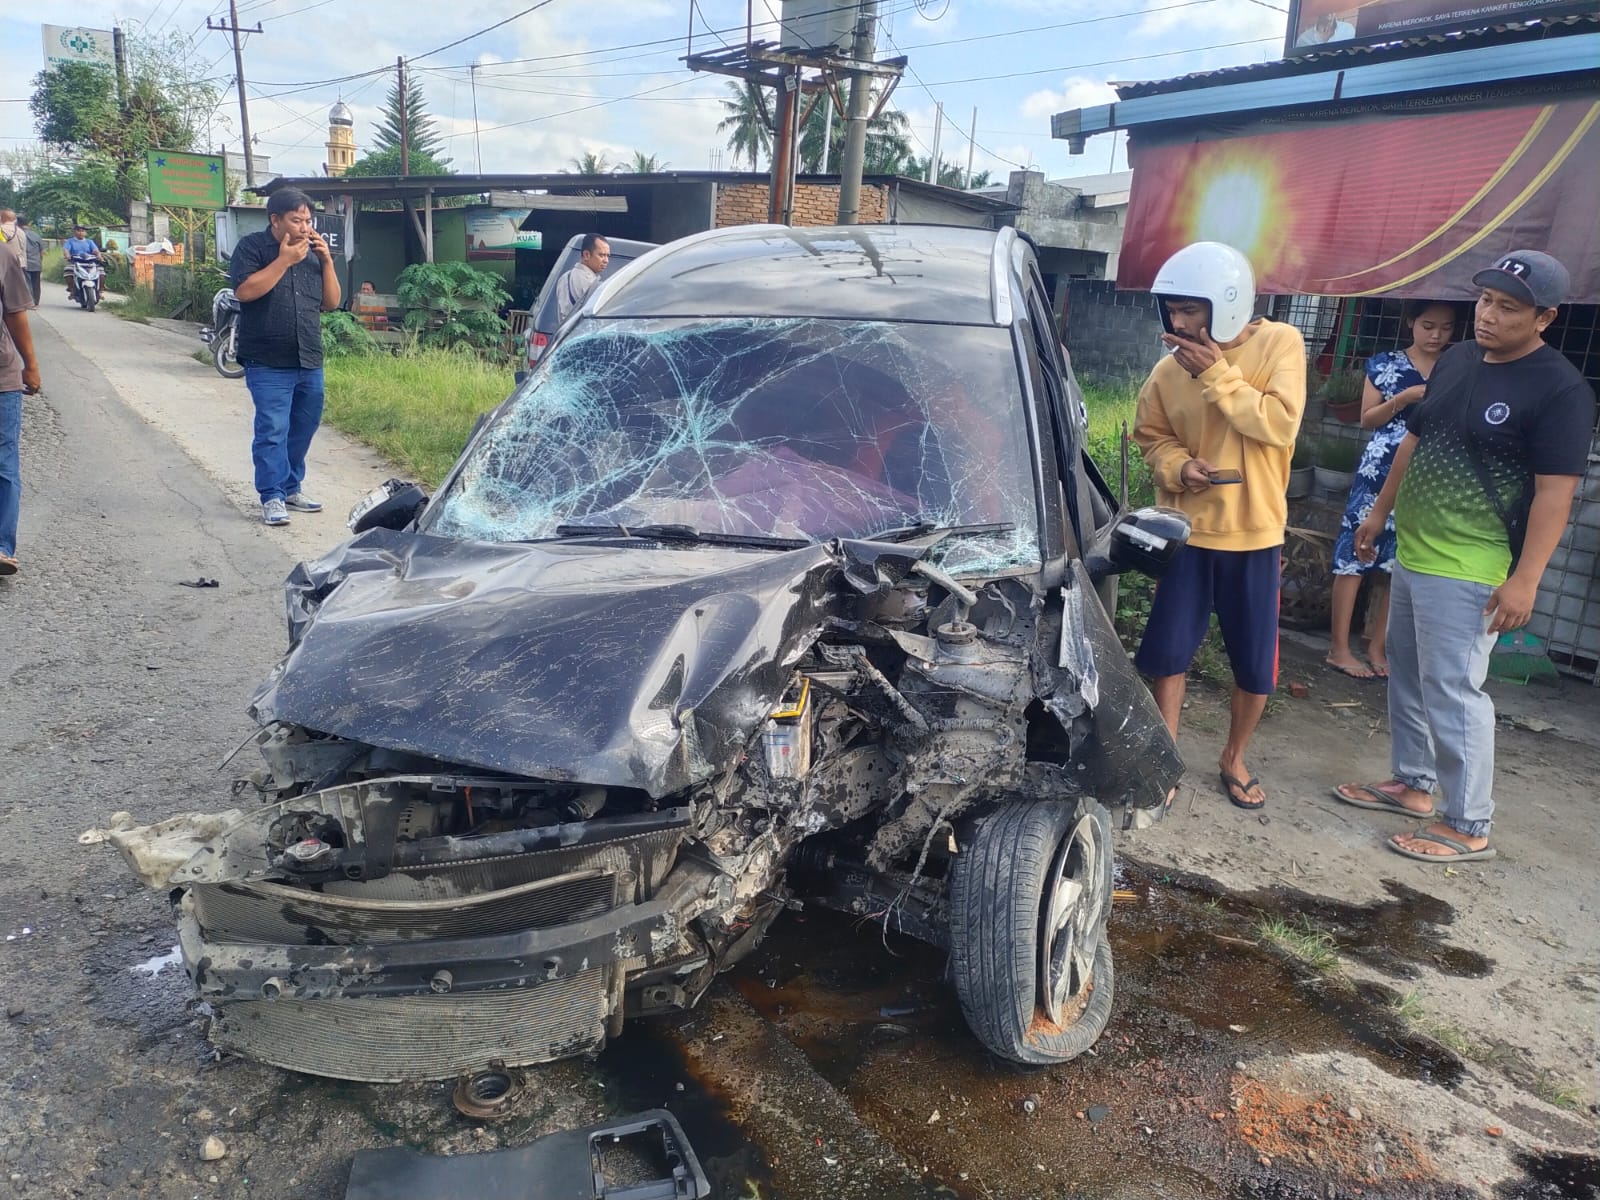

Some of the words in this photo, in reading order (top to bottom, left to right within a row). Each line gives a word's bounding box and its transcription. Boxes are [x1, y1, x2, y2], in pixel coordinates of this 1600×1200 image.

[1451, 8, 1480, 18] TERKENA
[1480, 3, 1508, 12] KANKER
[516, 234, 538, 242] KUAT
[1502, 260, 1525, 275] 17
